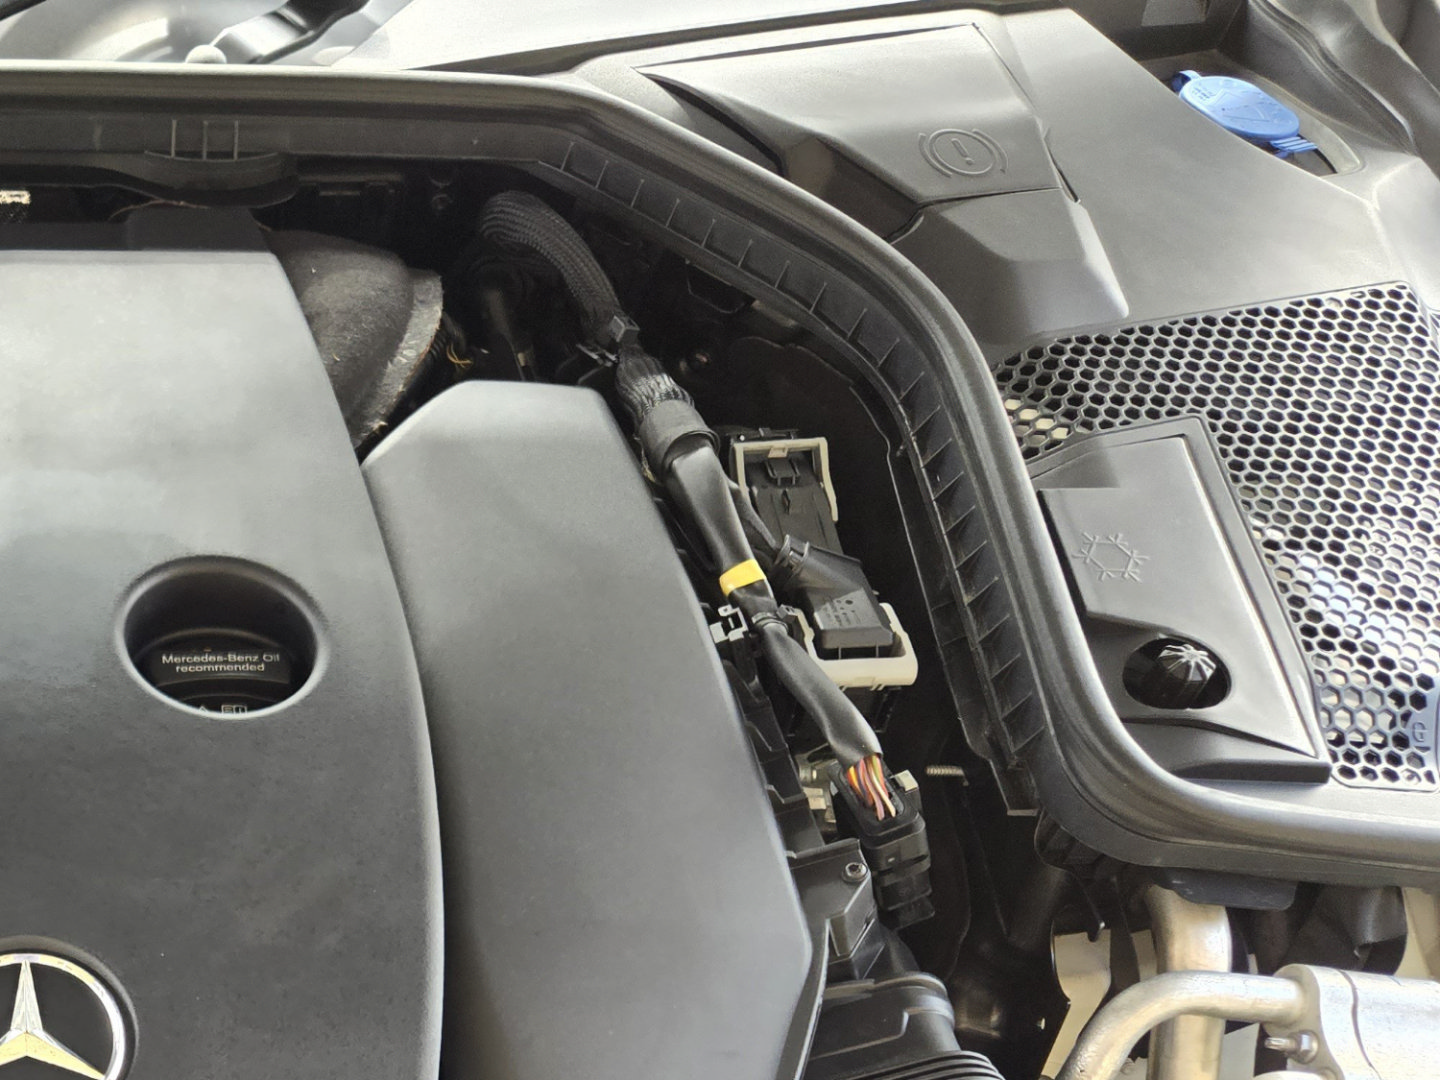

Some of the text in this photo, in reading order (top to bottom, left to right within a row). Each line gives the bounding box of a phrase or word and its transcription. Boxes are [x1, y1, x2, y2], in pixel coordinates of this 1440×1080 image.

[161, 652, 280, 664] Mercedes-Benz Oil
[175, 662, 265, 673] recommended
